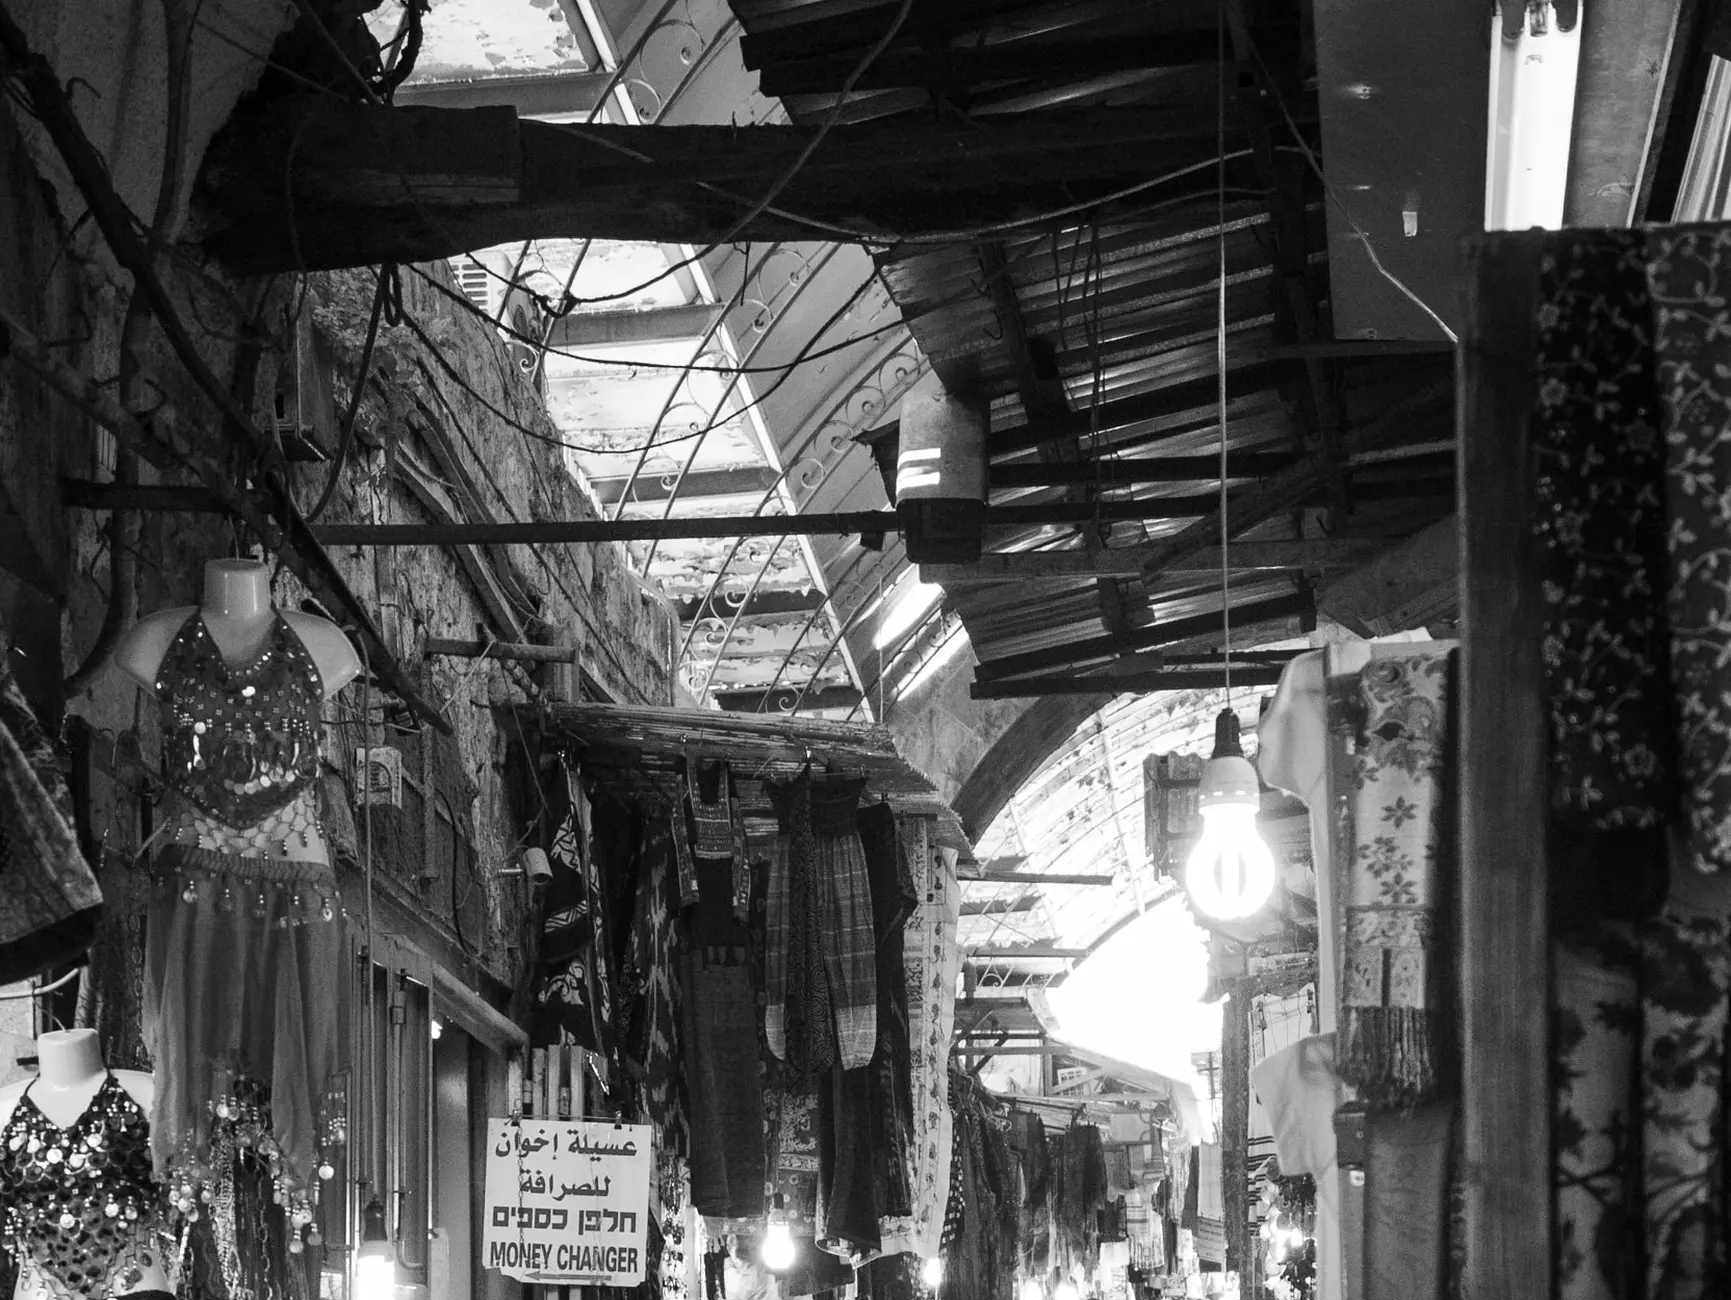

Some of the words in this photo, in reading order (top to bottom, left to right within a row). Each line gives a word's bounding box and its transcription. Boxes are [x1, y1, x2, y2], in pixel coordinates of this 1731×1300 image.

[495, 1129, 558, 1160] إخوان
[567, 1129, 637, 1162] عسيلة
[519, 1168, 612, 1201] للصرافة
[492, 1206, 568, 1230] כספים
[578, 1209, 637, 1235] חלפן
[490, 1241, 552, 1269] MONEY
[557, 1244, 638, 1273] CHANGER
